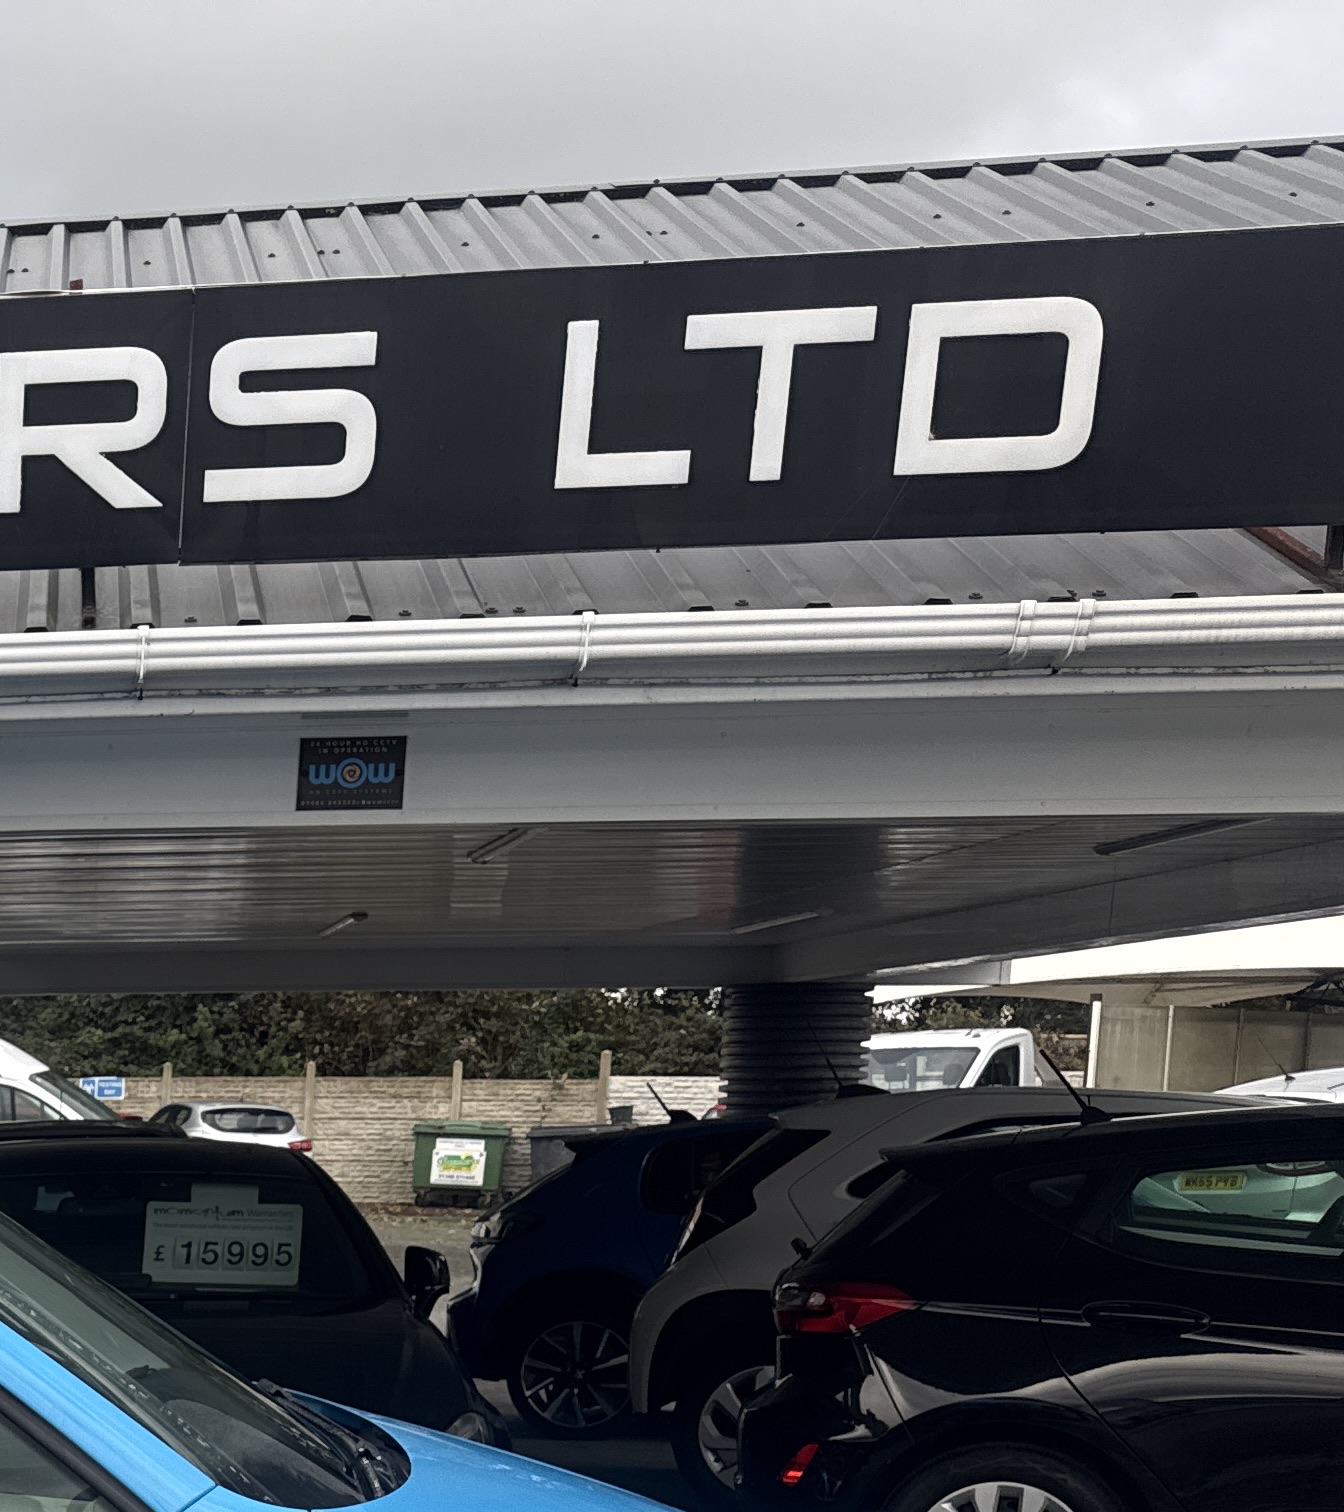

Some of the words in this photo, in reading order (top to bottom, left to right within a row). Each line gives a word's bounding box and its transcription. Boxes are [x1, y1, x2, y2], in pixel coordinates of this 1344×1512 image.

[554, 296, 1104, 489] LTD
[334, 746, 388, 754] OPERATION
[180, 1240, 293, 1267] 15995
